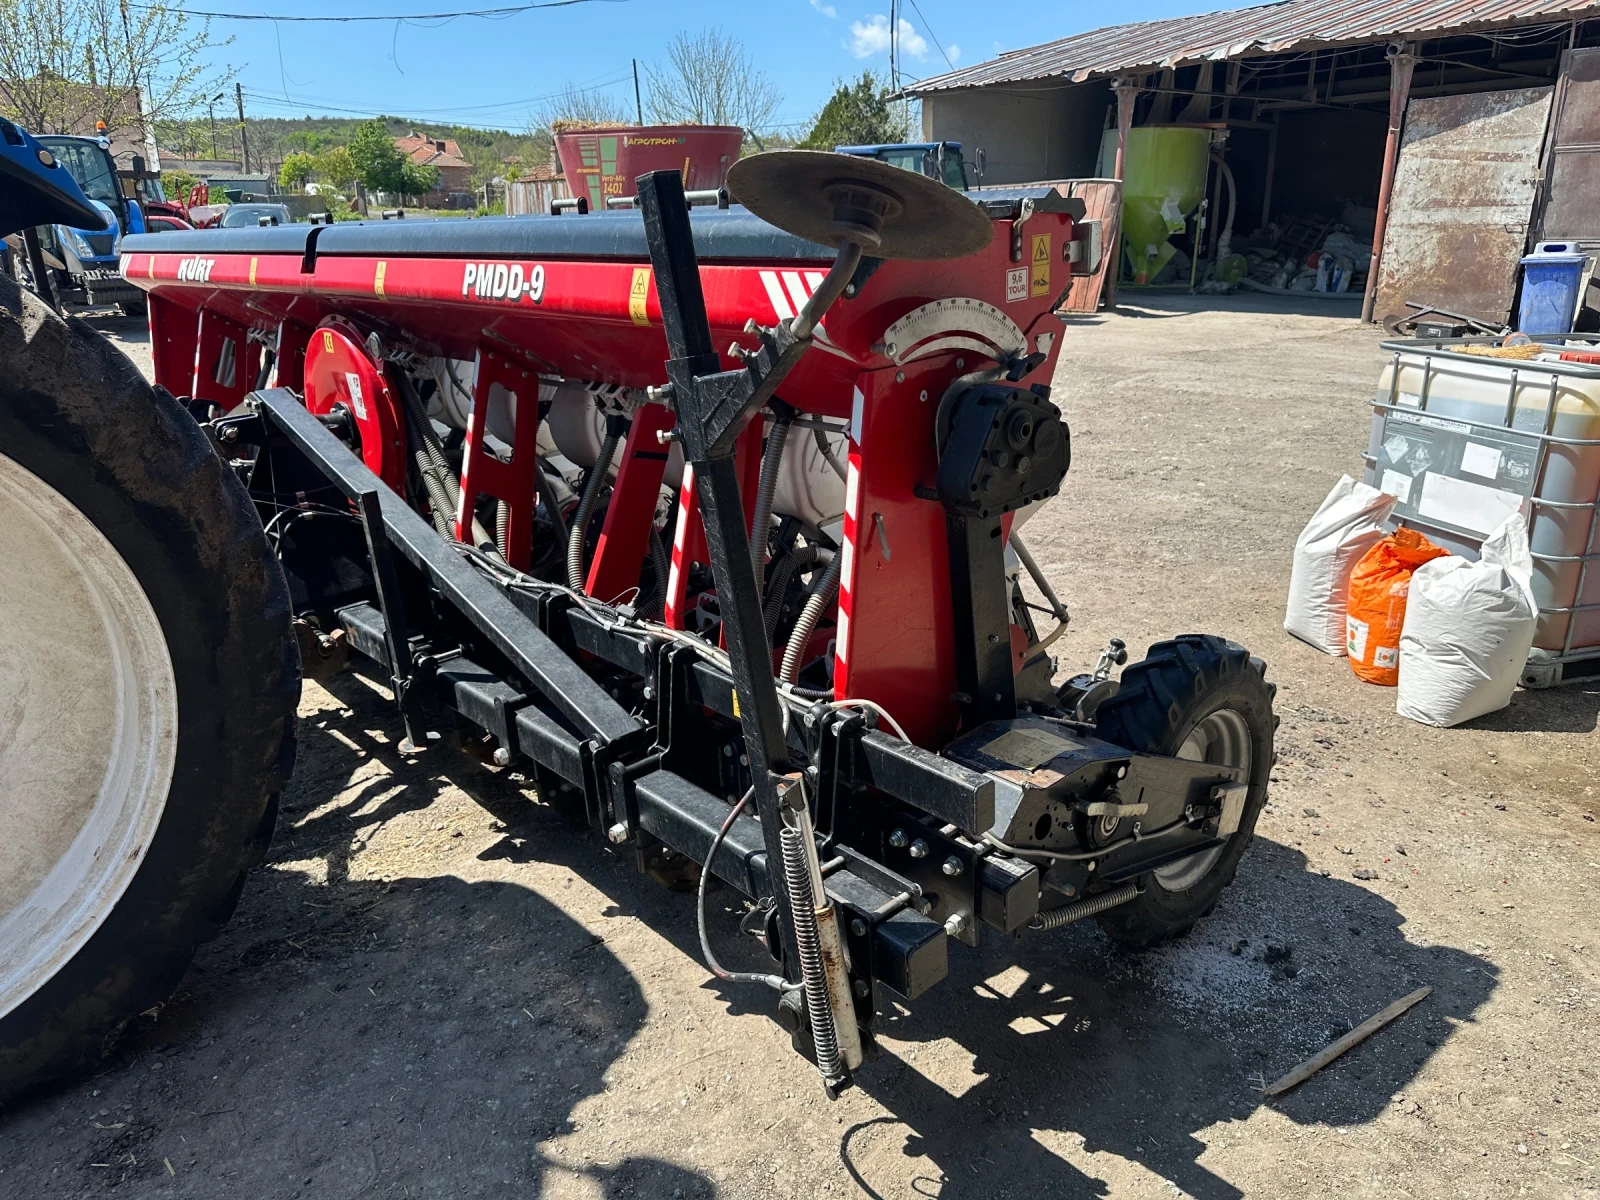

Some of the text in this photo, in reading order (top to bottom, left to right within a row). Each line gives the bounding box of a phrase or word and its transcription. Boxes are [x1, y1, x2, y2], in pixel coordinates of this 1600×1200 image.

[603, 182, 623, 194] 1401
[177, 256, 216, 284] KURT
[462, 263, 546, 304] PMDD-9
[1012, 273, 1023, 284] 9,6
[1008, 285, 1026, 295] TOUR
